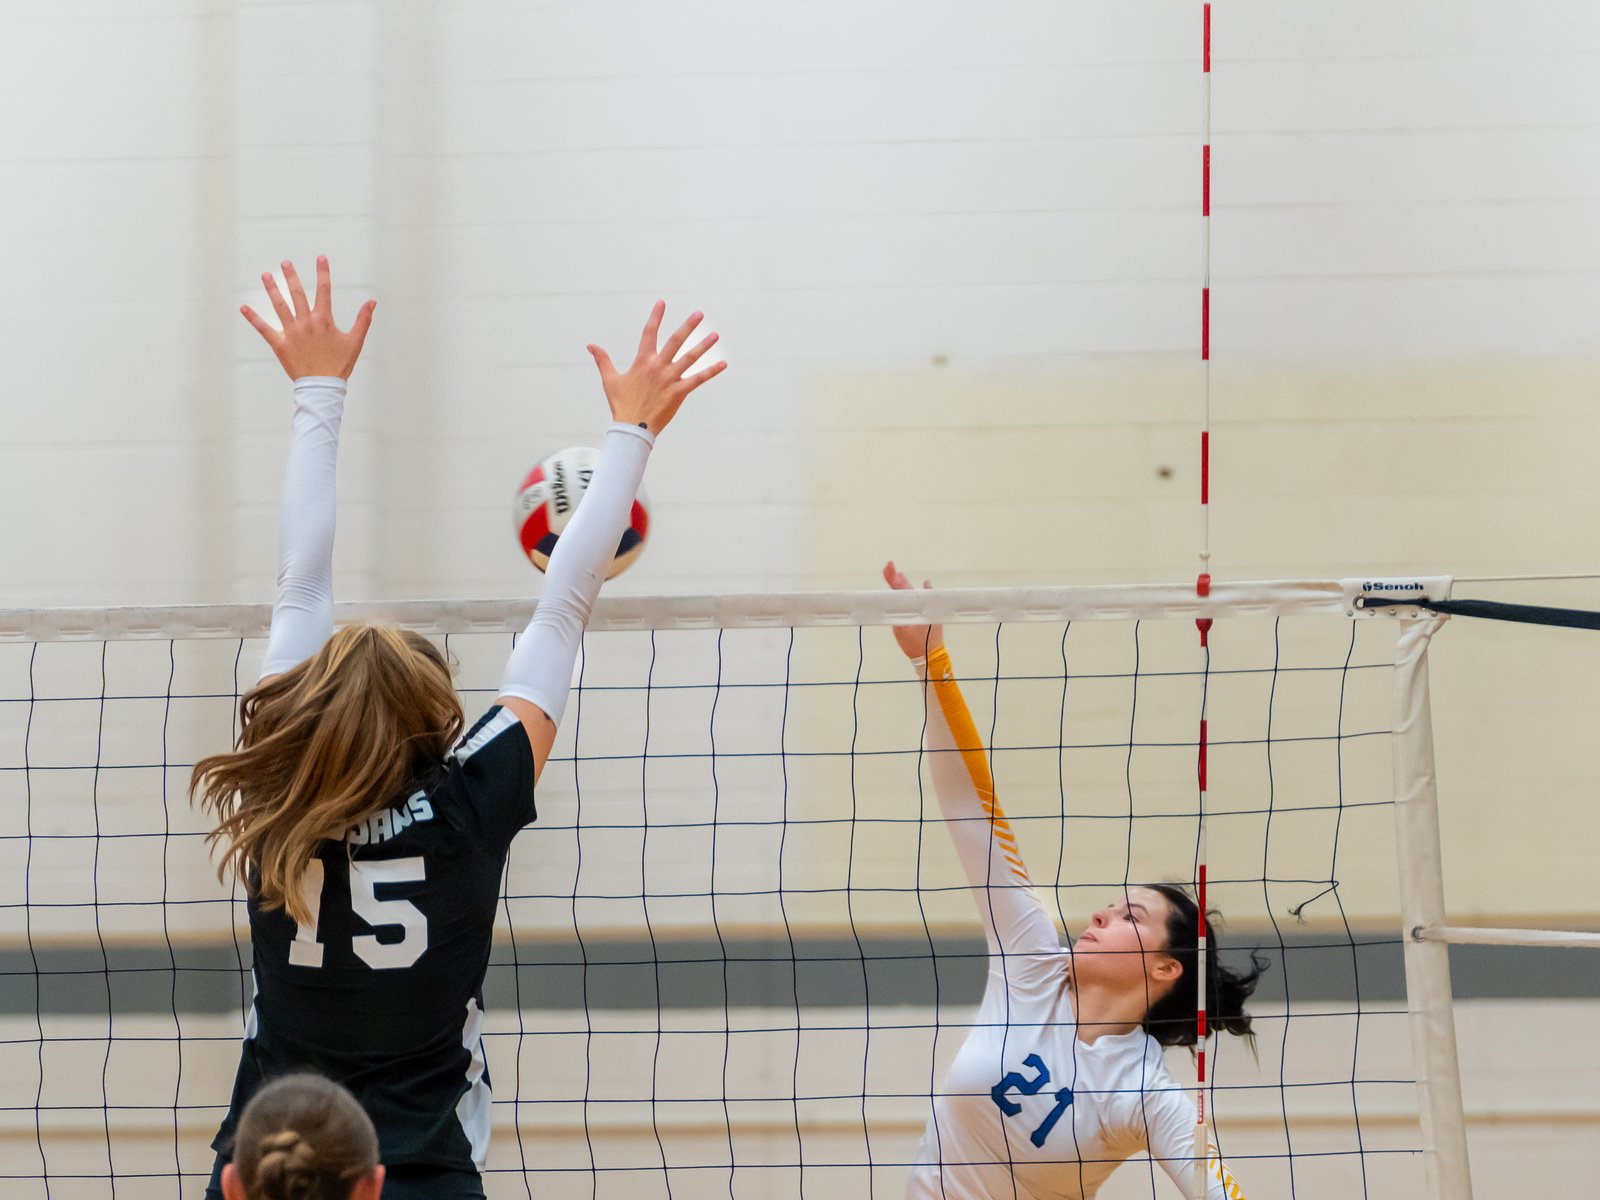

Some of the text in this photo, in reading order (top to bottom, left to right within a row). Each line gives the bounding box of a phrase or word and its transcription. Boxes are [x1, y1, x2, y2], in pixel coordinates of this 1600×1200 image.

[1373, 582, 1424, 591] Senoh
[288, 856, 428, 970] 15
[991, 1053, 1074, 1149] 21
